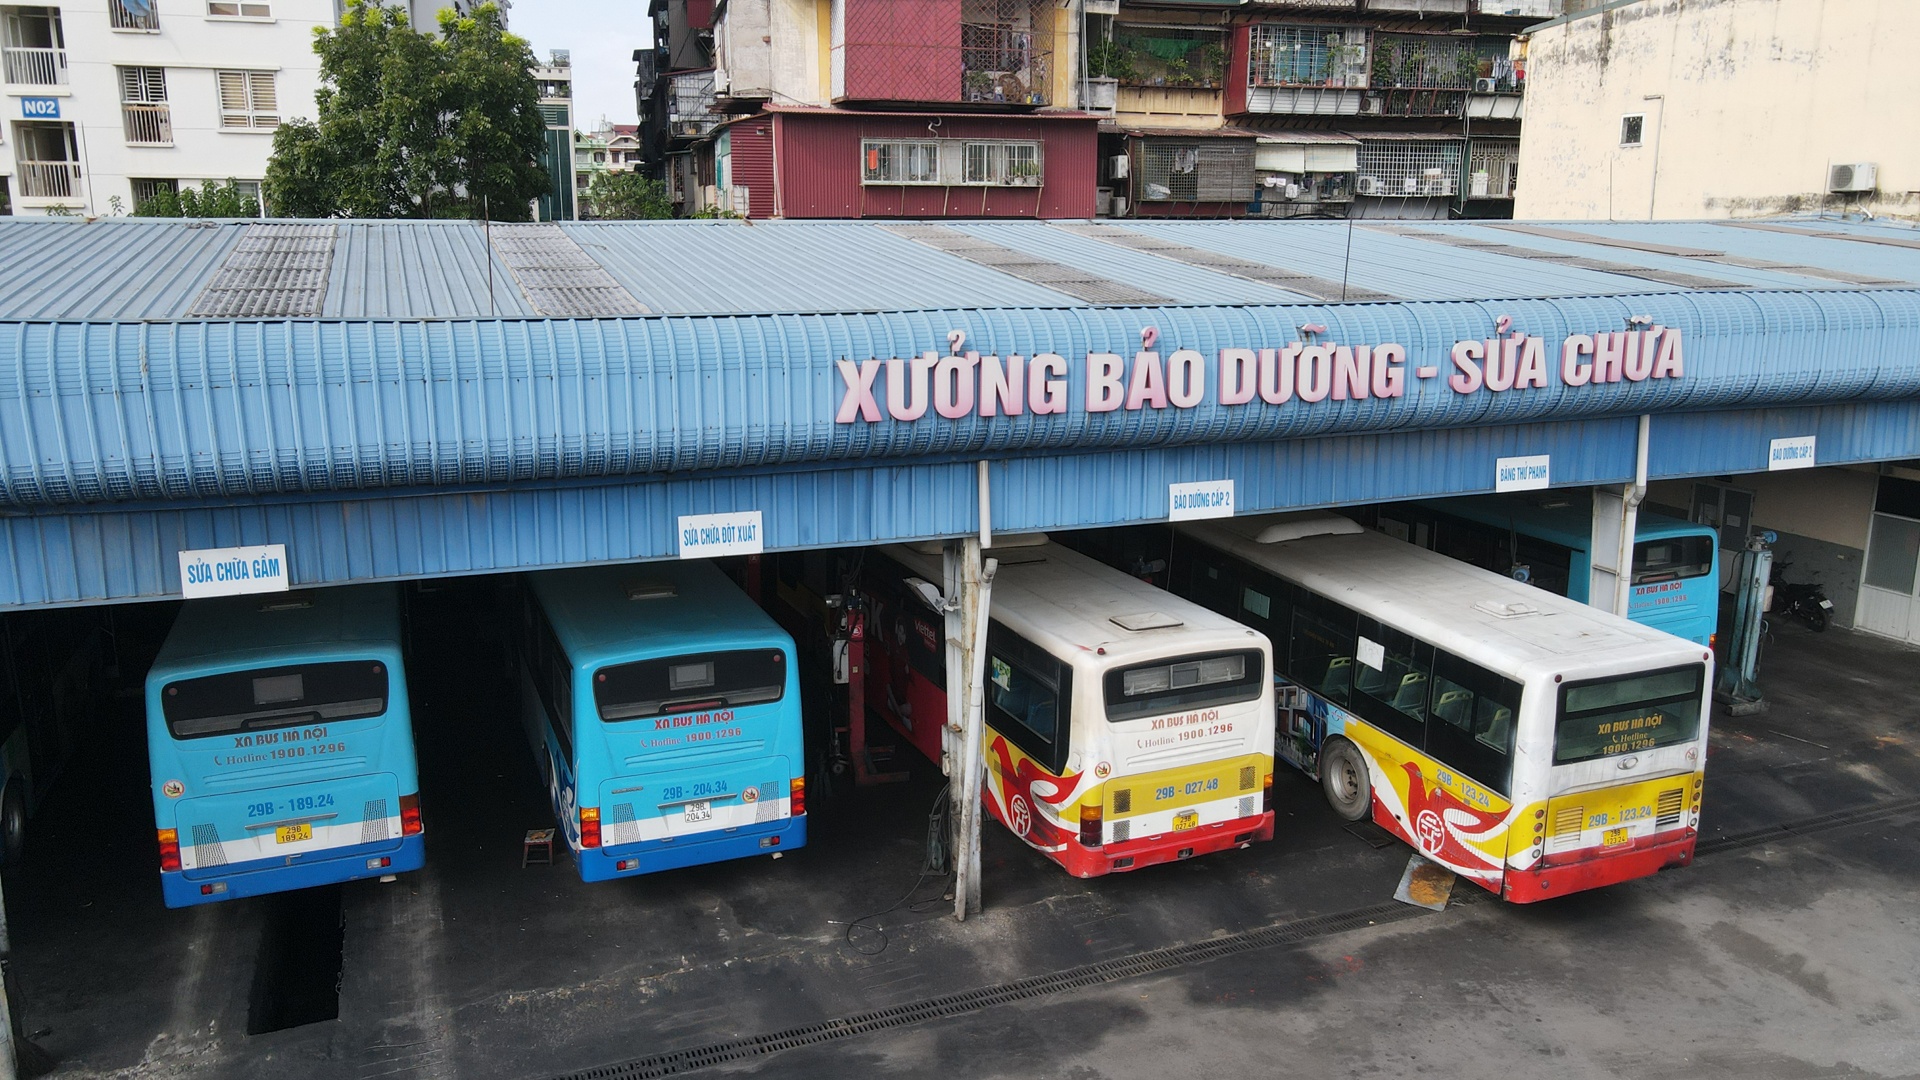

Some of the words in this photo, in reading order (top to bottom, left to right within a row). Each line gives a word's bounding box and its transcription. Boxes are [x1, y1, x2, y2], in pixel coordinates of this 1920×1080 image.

[24, 100, 57, 115] N02
[836, 329, 1068, 423] XƯỞNG
[1086, 326, 1205, 412] BẢO
[1219, 323, 1406, 406] DƯỠNG
[1416, 366, 1438, 379] -
[1449, 315, 1548, 394] SỬA
[1560, 315, 1684, 388] CHỮA
[1500, 465, 1516, 482] BĂNG
[1529, 465, 1547, 480] PHANH
[1174, 489, 1187, 509] BẢO
[1188, 488, 1210, 509] DƯỠNG
[1211, 486, 1224, 507] CẤP
[1225, 491, 1230, 506] 2
[683, 522, 699, 547] SỬA
[700, 523, 720, 545] CHỮA
[721, 522, 736, 547] ĐỘT
[737, 519, 757, 543] XUẤT
[187, 557, 214, 584] SỬA
[216, 557, 250, 582] CHỮA
[252, 552, 281, 578] GẦM
[673, 715, 692, 728] BUS
[696, 711, 710, 725] HÀ
[713, 708, 734, 724] NỘI
[1167, 715, 1184, 728] BUS
[1186, 711, 1199, 725] HÀ
[1201, 709, 1219, 724] NỘI
[1613, 719, 1630, 732] BUS
[1631, 715, 1644, 729] HÀ
[1645, 713, 1663, 729] NỘI
[256, 732, 279, 745] BUS
[283, 727, 300, 743] HÀ
[303, 725, 328, 741] NỘI
[686, 727, 742, 742] 1900.1296
[1145, 736, 1176, 748] Hotline
[1178, 723, 1233, 741] 1900.1296
[1621, 732, 1648, 743] Hotline
[226, 753, 268, 765] Hotline
[270, 742, 346, 760] 1900.1296
[1603, 738, 1655, 755] 1900.1296
[663, 787, 682, 800] 29B
[693, 780, 728, 796] 204.34
[1156, 786, 1175, 800] 29B
[1185, 778, 1219, 795] 027.48
[1437, 768, 1452, 786] 29B
[1461, 782, 1490, 807] 123.24
[247, 801, 274, 818] 29B
[288, 793, 335, 812] 189.24
[1588, 813, 1608, 827] 29B
[1618, 805, 1652, 821] 123.24
[286, 825, 302, 834] 29B
